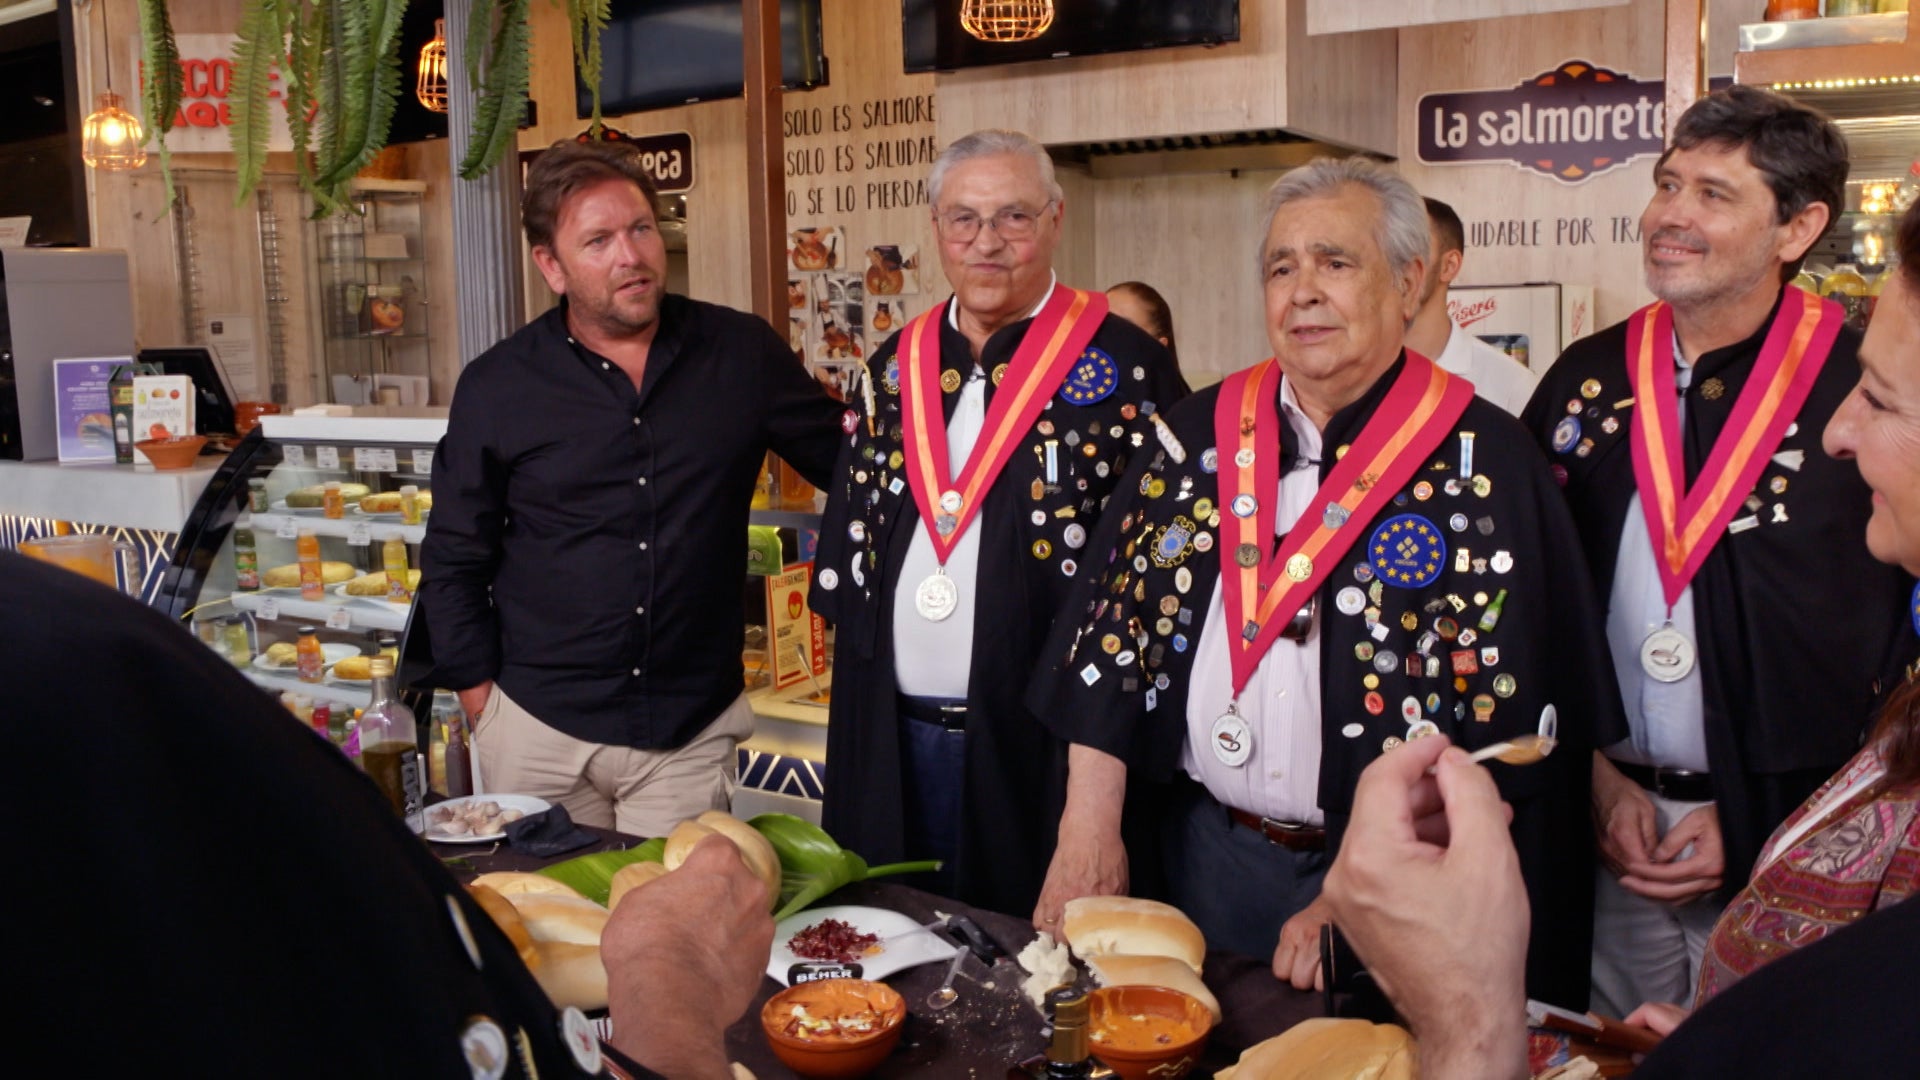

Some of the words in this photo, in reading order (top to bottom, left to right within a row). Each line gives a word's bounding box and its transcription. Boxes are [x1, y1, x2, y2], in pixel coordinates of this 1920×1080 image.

[784, 107, 822, 138] SOLO
[833, 104, 852, 132] ES
[863, 94, 936, 129] SALMORE
[1434, 107, 1468, 149] la
[786, 147, 825, 178] SOLO
[836, 144, 854, 173] ES
[807, 187, 824, 215] SE
[836, 185, 856, 213] LO
[1556, 216, 1596, 246] POR
